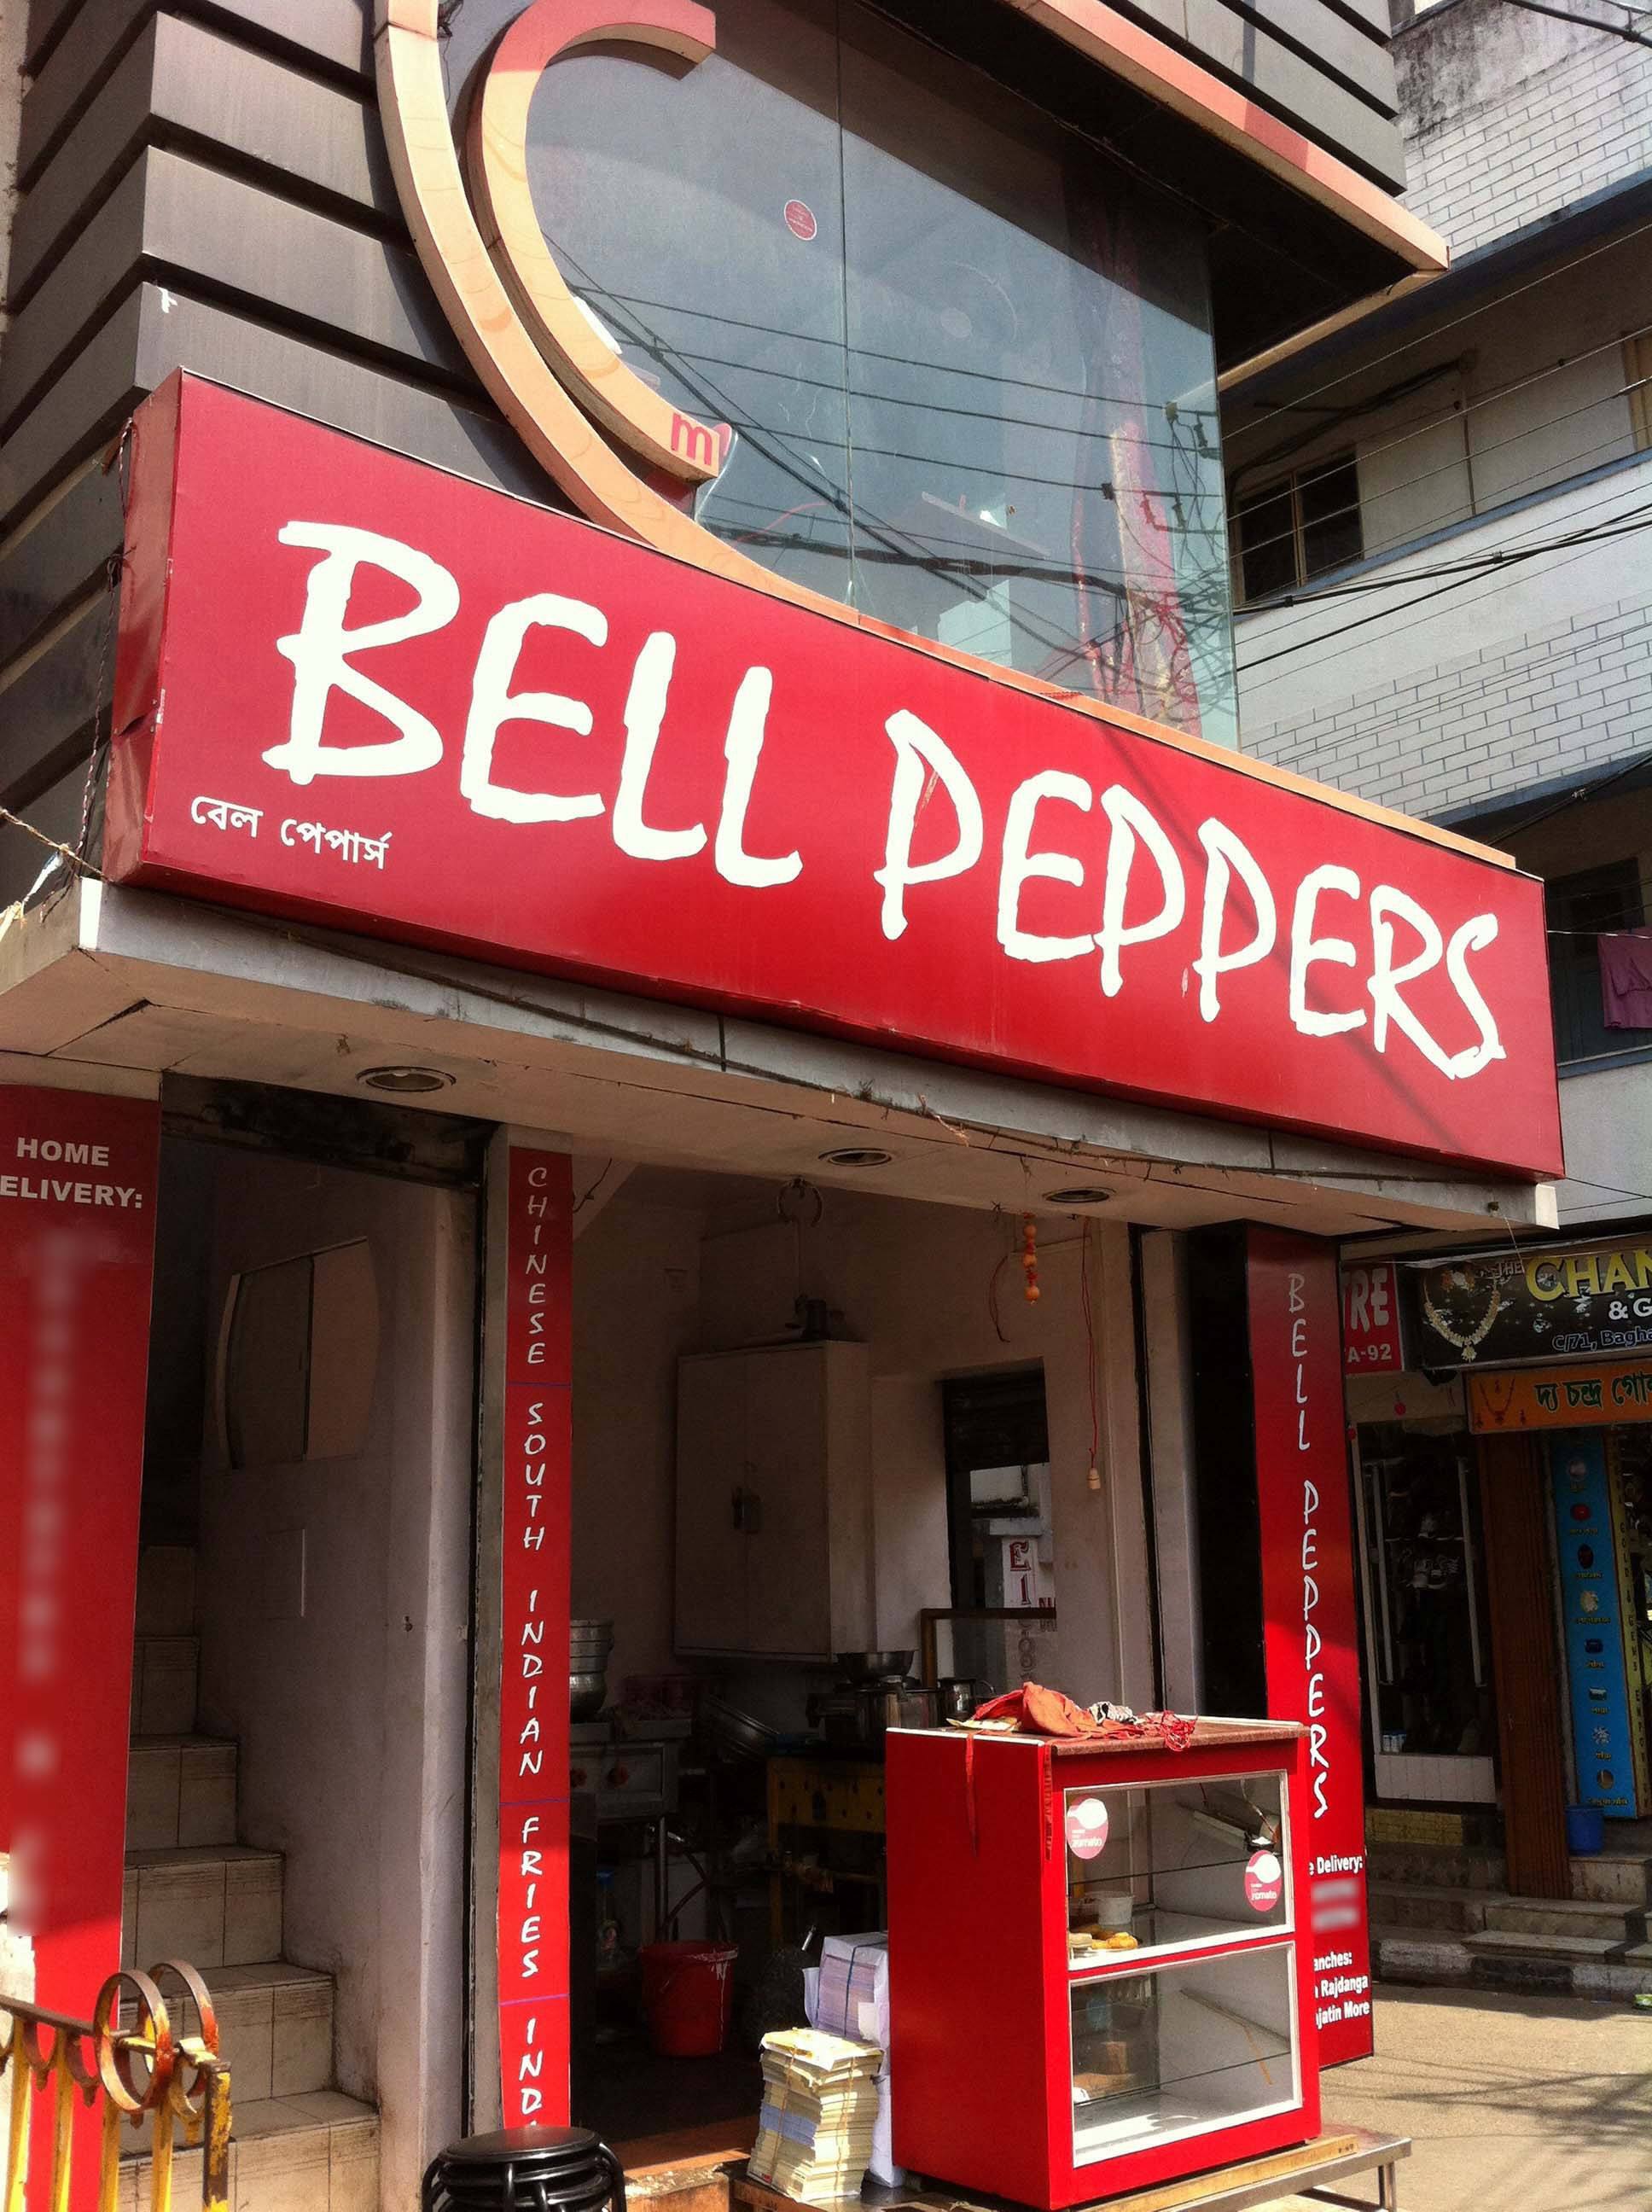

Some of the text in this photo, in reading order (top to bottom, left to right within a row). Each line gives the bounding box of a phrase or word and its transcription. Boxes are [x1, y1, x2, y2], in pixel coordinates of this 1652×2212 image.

[190, 795, 393, 870] বেল পেপার্স
[261, 520, 1506, 1080] BELL PEPPERS
[16, 1137, 110, 1167] HOME
[0, 1174, 143, 1209] ELIVERY:
[525, 1167, 549, 1365] CHINESE
[1608, 1300, 1629, 1321] &
[1288, 1272, 1311, 1451] BELL
[1344, 1342, 1393, 1365] A-92
[519, 1402, 547, 1777] SOUTH INDIAN
[1301, 1479, 1330, 1819] PEPPERS
[521, 1816, 544, 1978] FRIES
[1317, 1854, 1363, 1875] Delivery:
[1320, 1975, 1369, 1999] Rajdanga
[1343, 2000, 1370, 2020] More
[519, 2017, 544, 2125] IND
